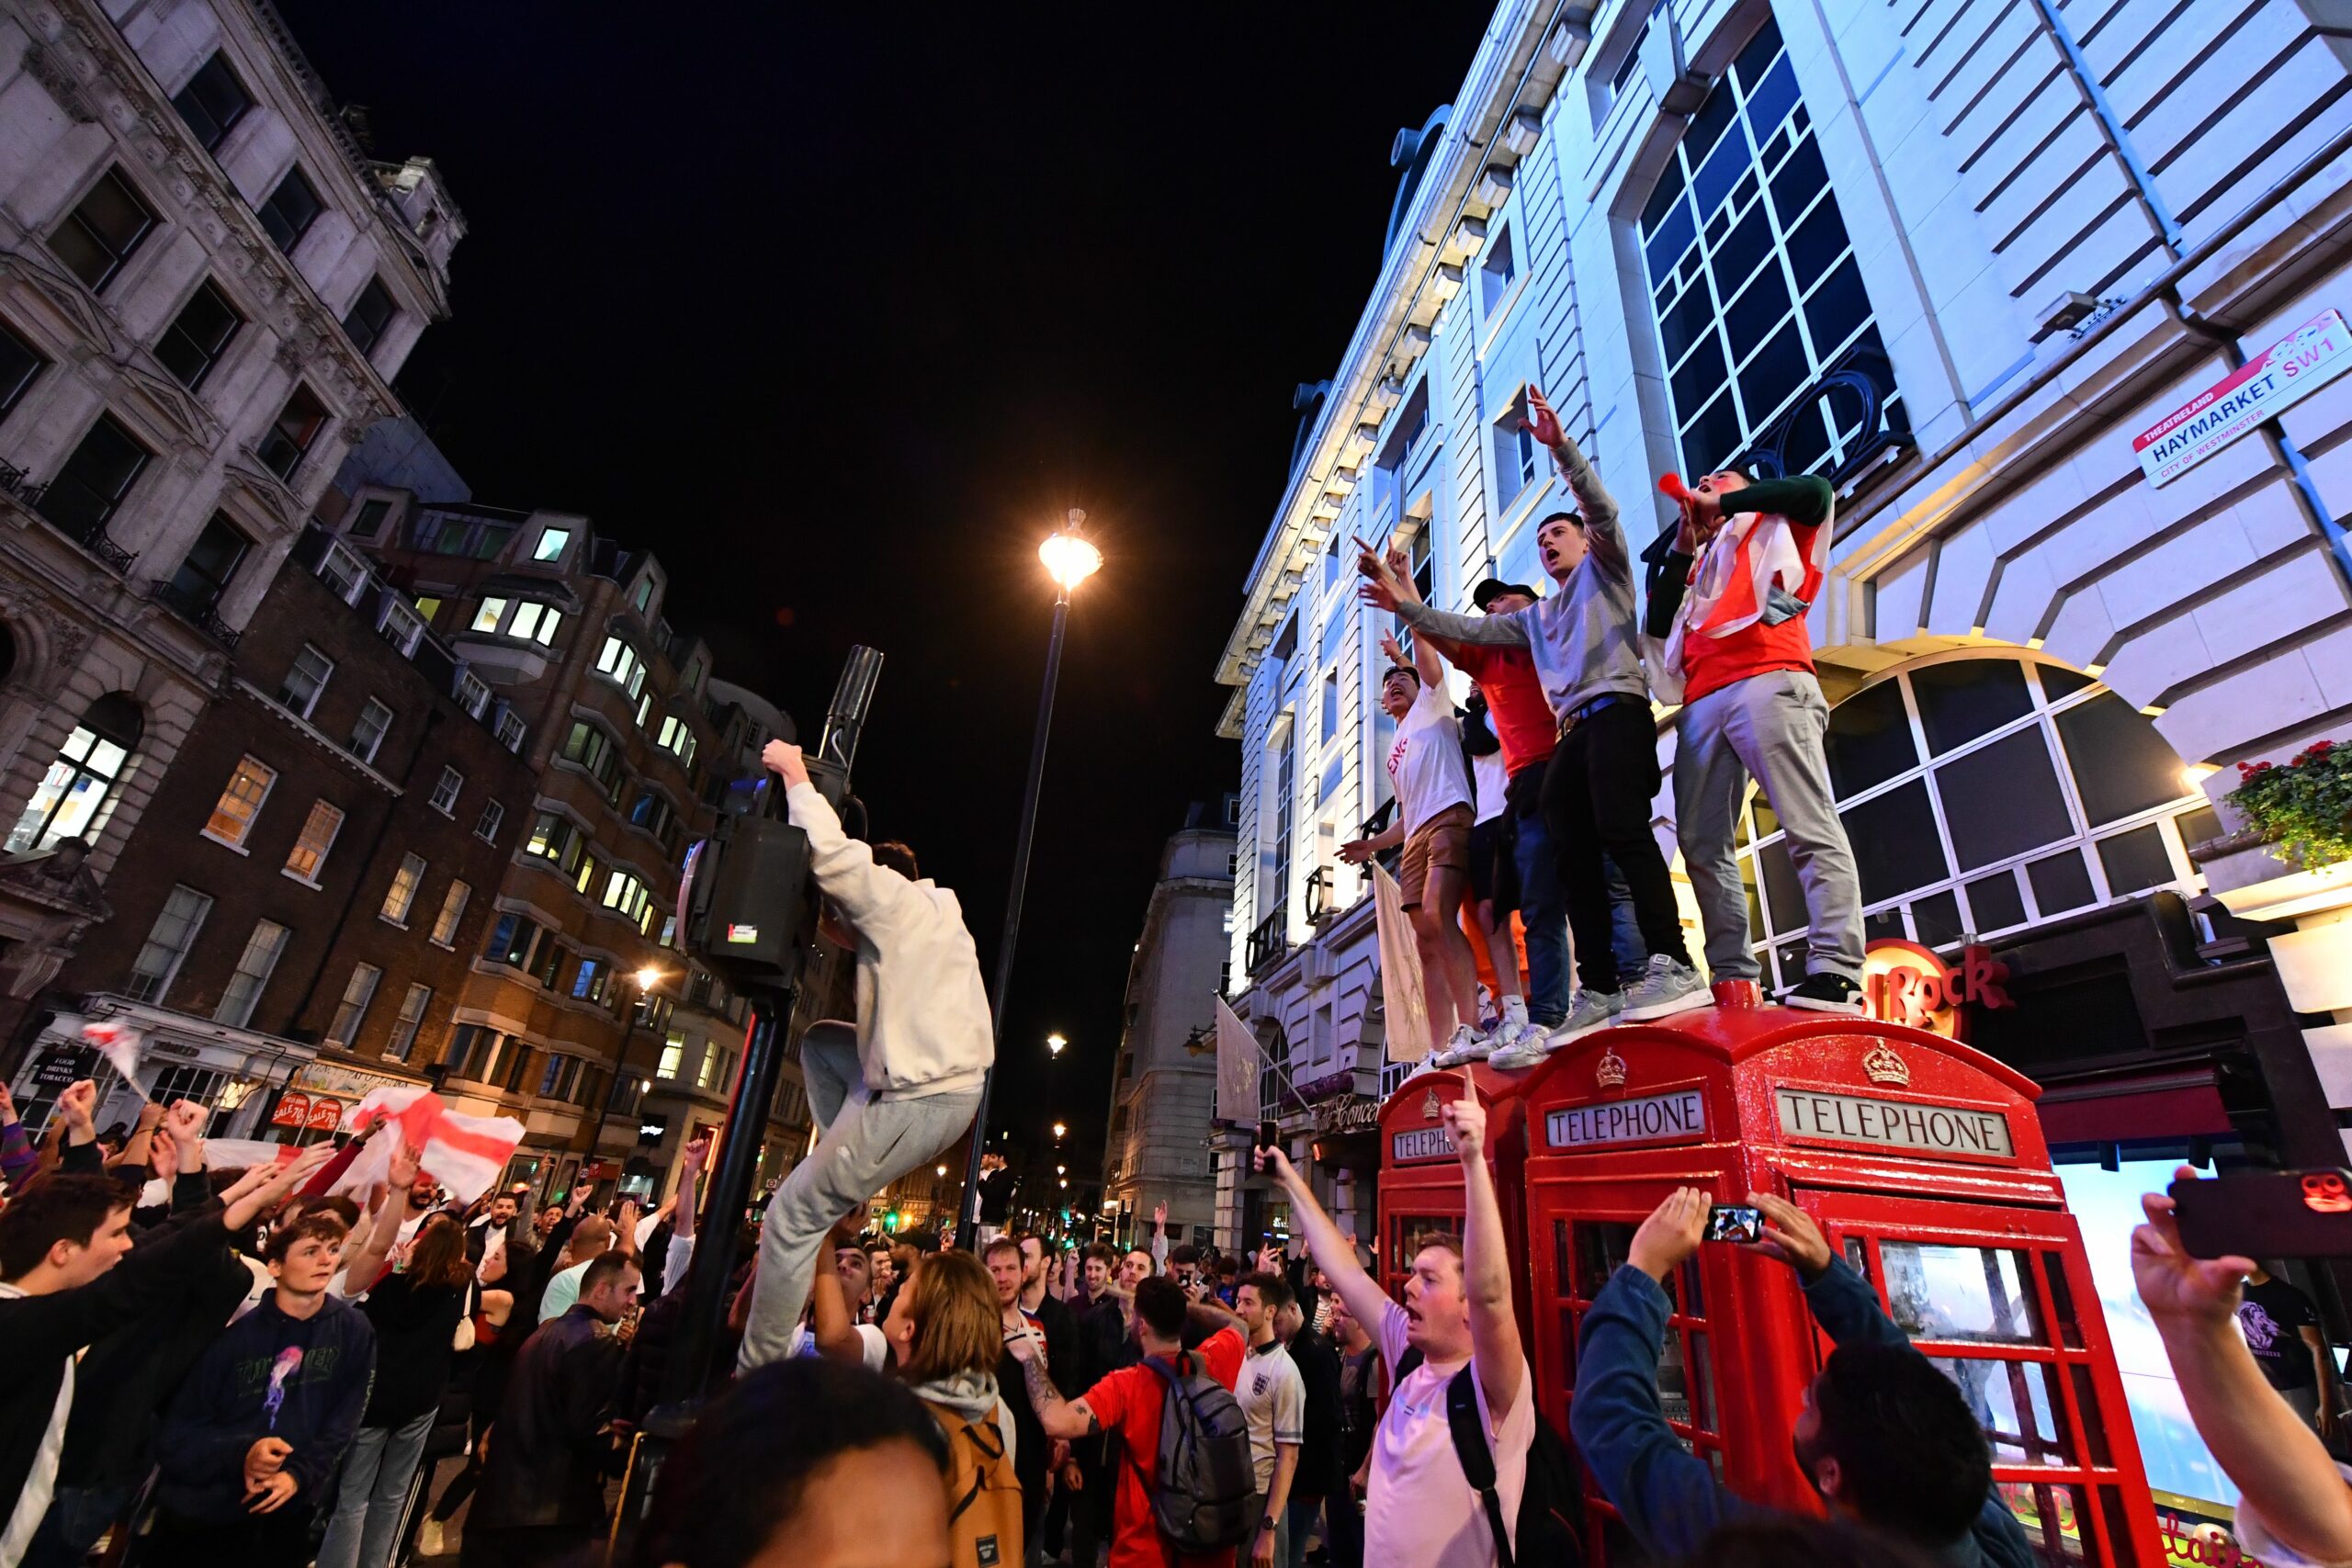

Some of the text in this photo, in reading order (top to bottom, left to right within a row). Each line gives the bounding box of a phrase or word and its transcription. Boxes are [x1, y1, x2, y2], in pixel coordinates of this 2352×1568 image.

[2152, 337, 2335, 463] HAYMARKET SW1
[2143, 392, 2214, 443] THEATRELAND
[2161, 410, 2265, 478] CITY OF WESTMINSTER
[46, 1065, 74, 1075] DRINKS
[54, 1057, 75, 1066] FOOD
[40, 1073, 74, 1083] TOBACCO
[272, 1104, 293, 1121] SALE
[307, 1110, 327, 1125] SALE
[1552, 1096, 1699, 1144] TELEPHONE
[1781, 1094, 2001, 1153] TELEPHONE
[1397, 1130, 1456, 1158] TELEPHO
